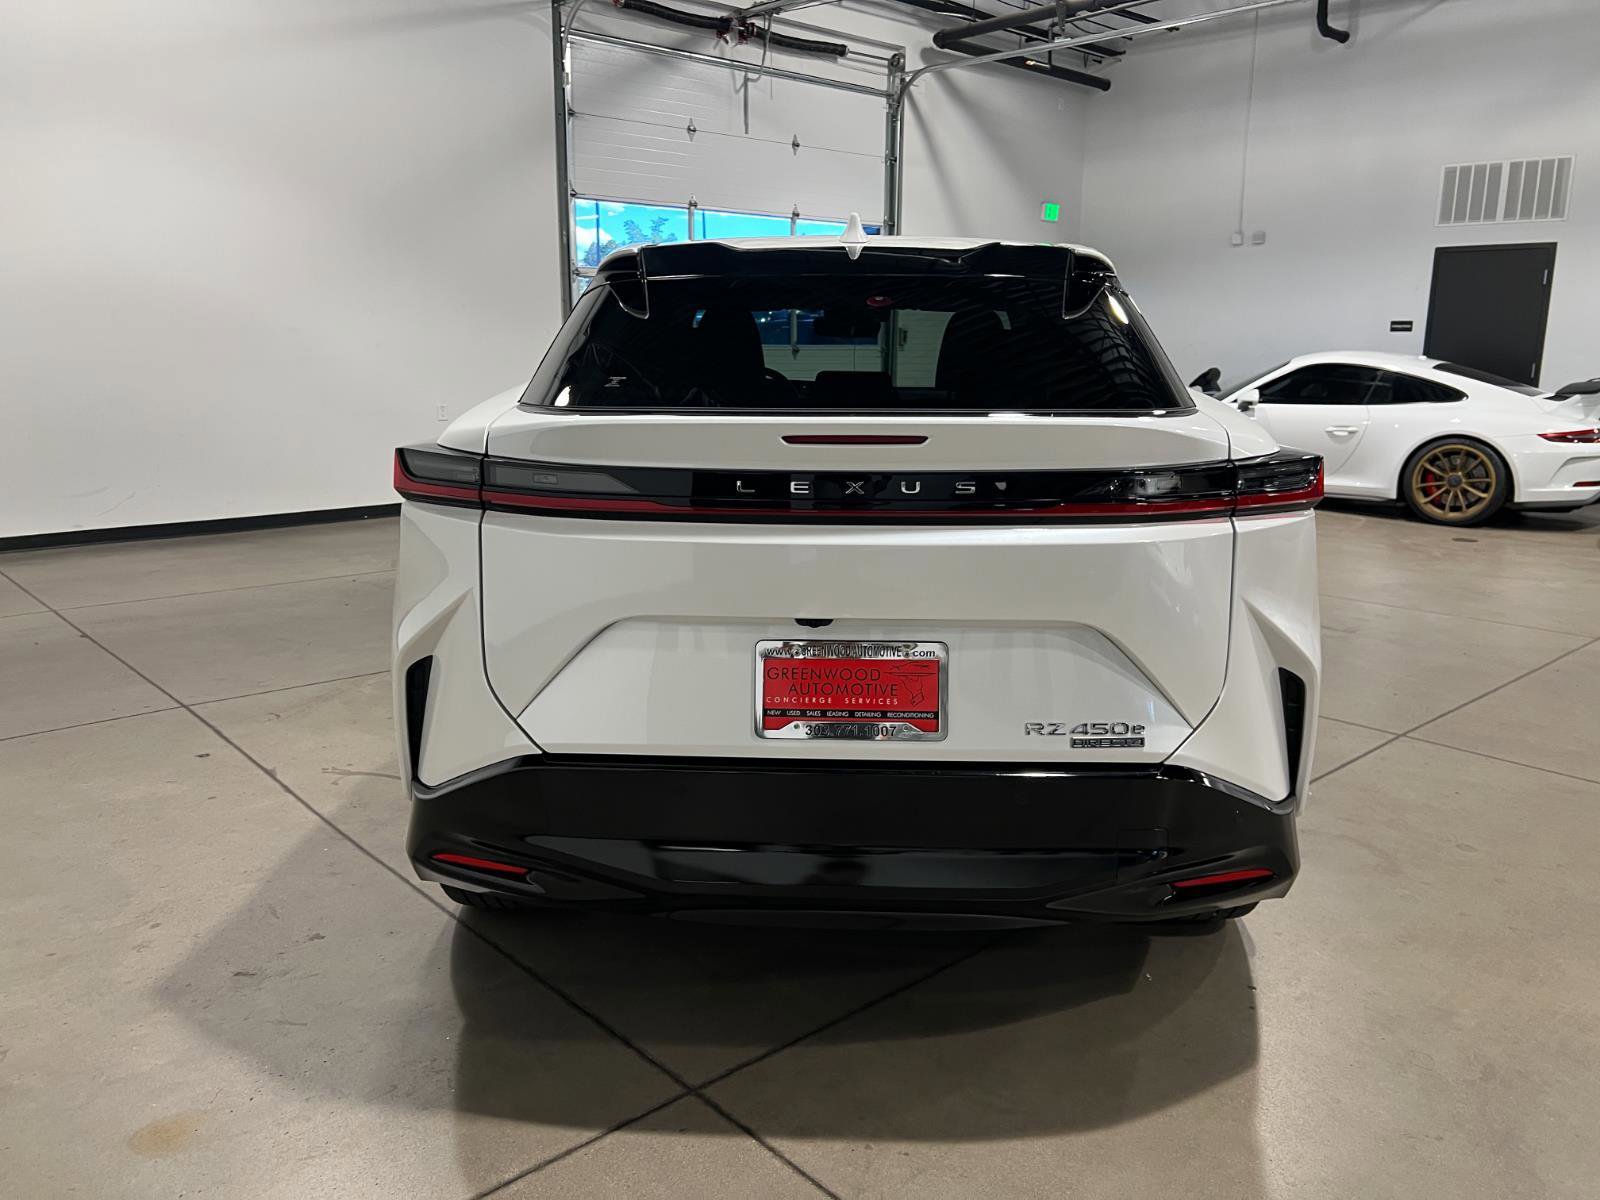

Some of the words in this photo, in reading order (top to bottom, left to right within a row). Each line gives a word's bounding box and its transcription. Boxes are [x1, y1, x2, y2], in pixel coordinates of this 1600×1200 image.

[736, 480, 976, 495] LEXUS
[767, 667, 881, 681] GREENWOOD
[788, 682, 898, 697] AUTOMOTIVE
[766, 696, 832, 704] CONCIERGE
[844, 697, 898, 705] SERVICES
